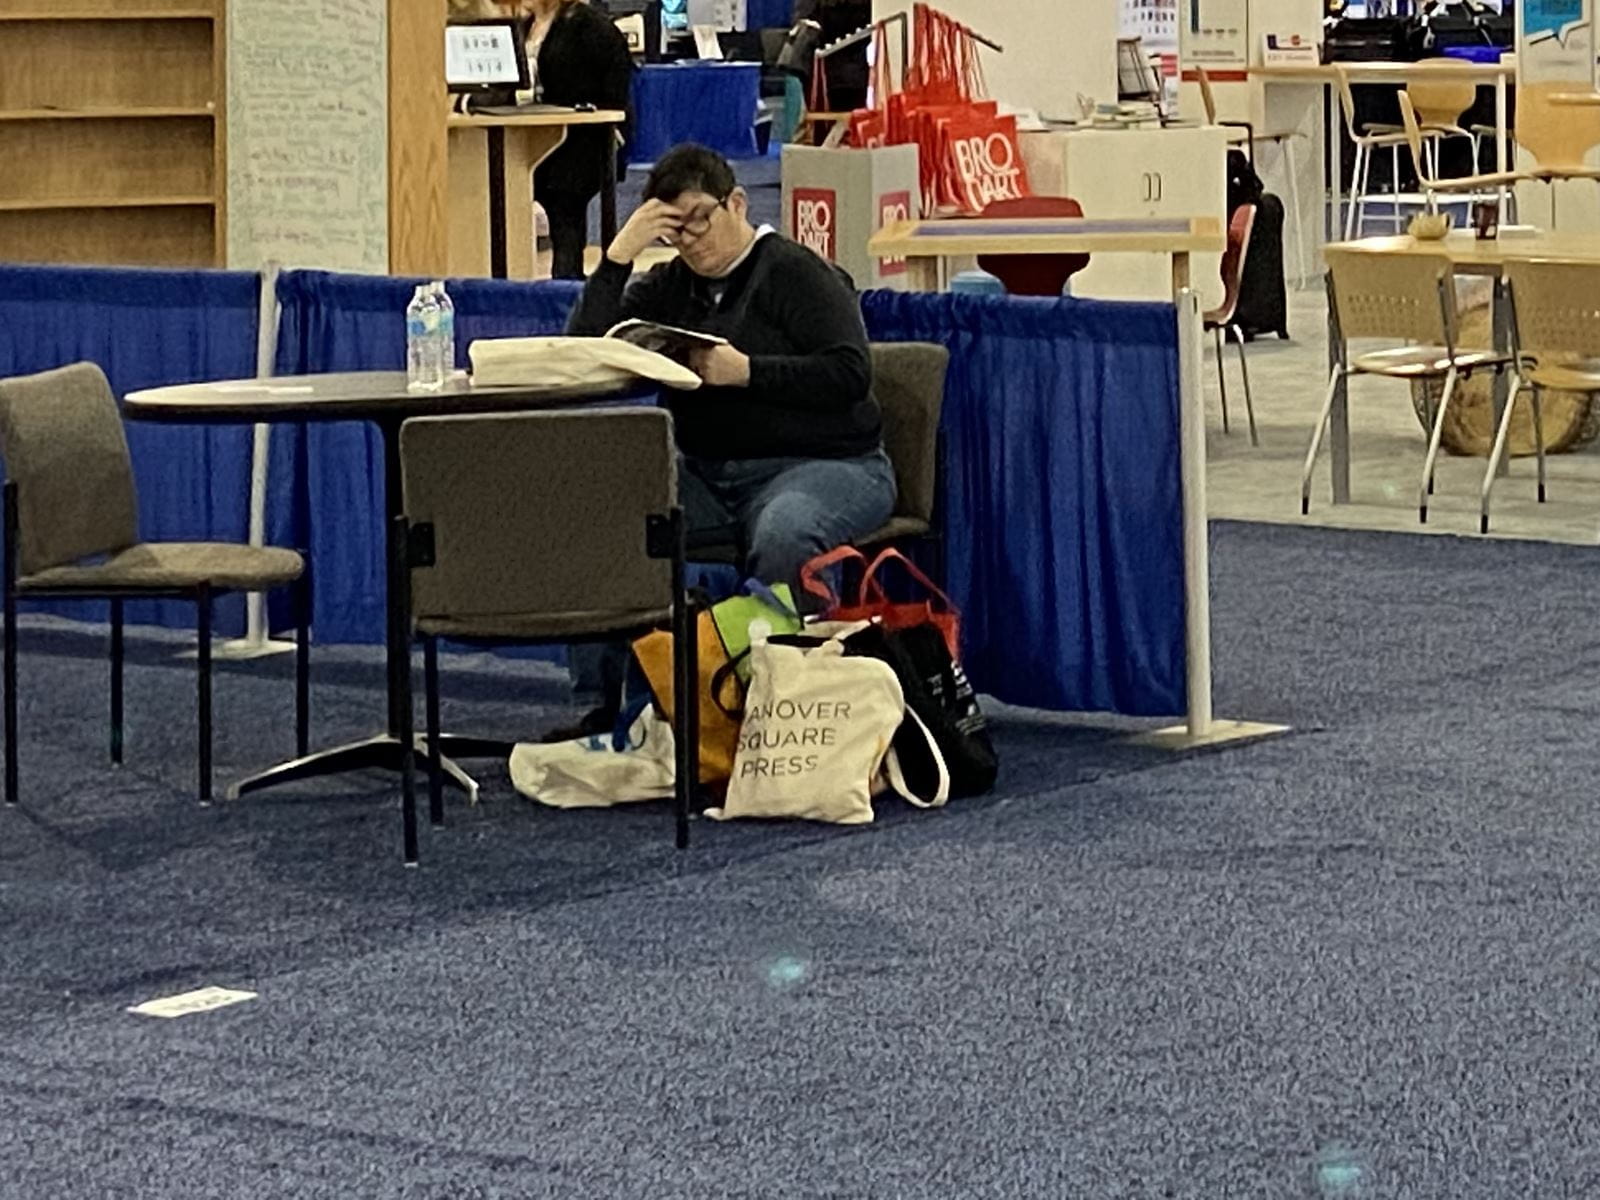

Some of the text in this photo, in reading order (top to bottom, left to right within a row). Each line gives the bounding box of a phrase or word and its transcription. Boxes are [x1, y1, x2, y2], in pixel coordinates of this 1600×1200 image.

[955, 132, 1013, 179] BRO
[737, 727, 837, 753] SQUARE
[741, 754, 819, 778] PRESS
